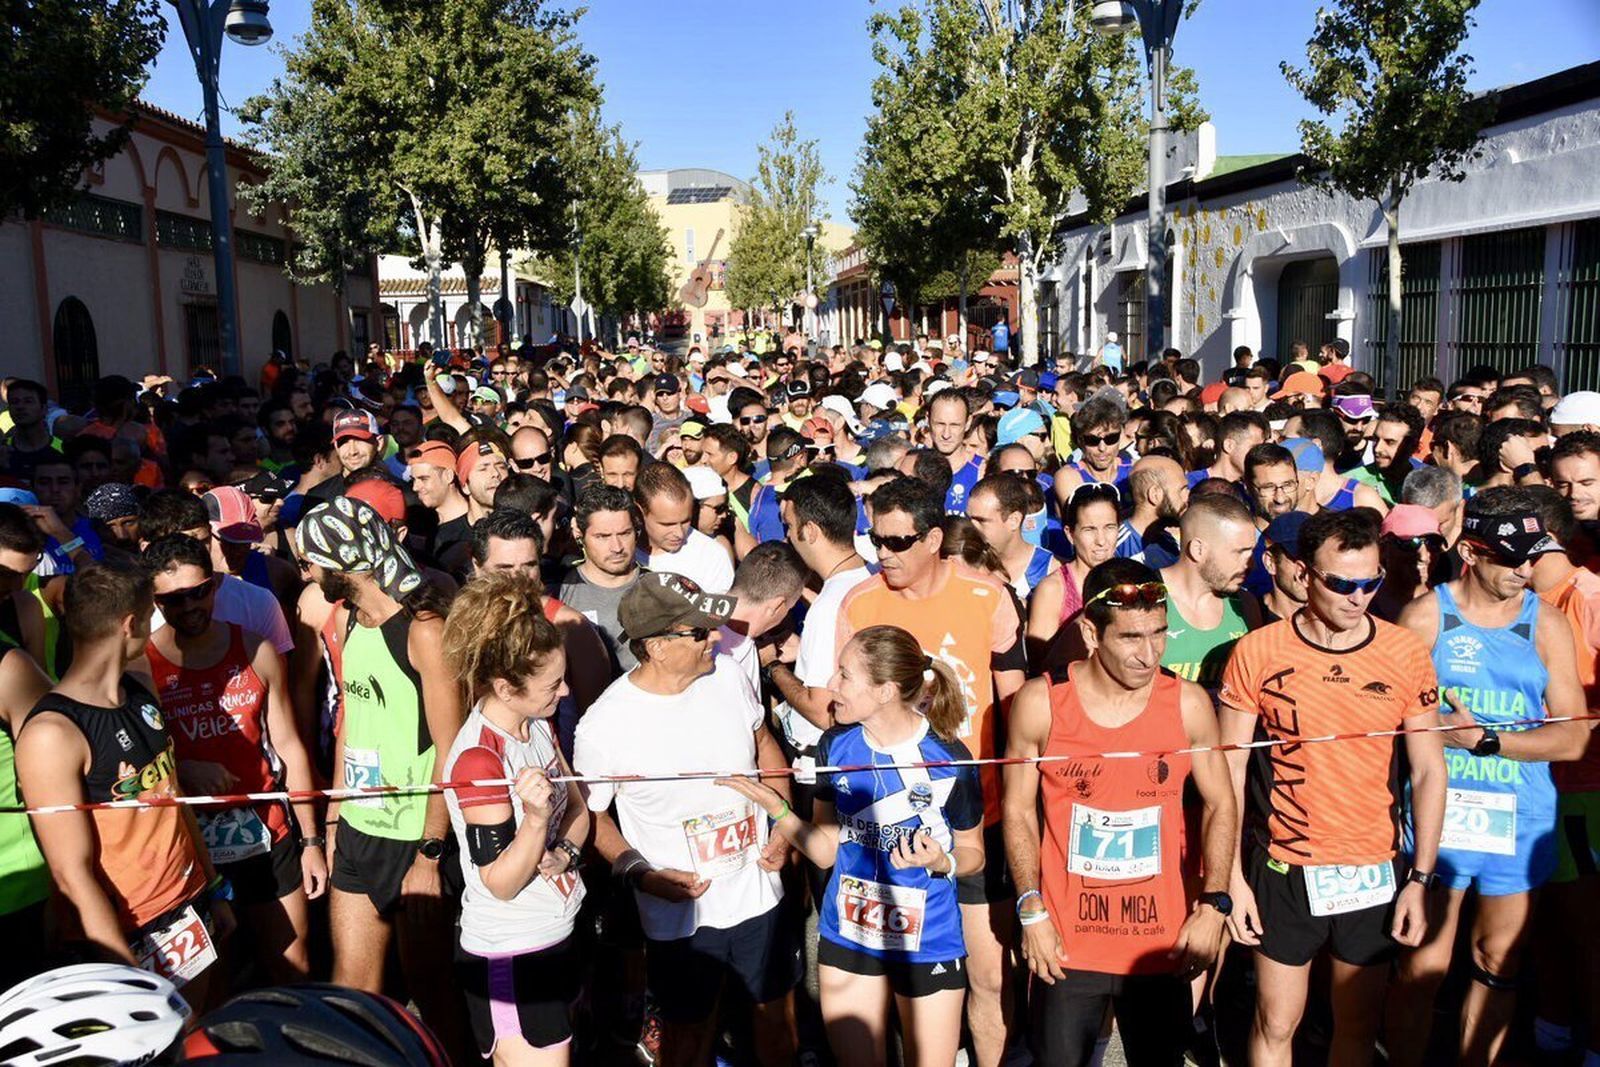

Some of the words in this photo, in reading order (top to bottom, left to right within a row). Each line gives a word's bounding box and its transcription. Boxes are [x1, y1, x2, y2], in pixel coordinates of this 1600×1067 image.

[695, 820, 753, 863] 742
[1091, 829, 1135, 861] 71
[847, 898, 910, 933] 746
[1079, 892, 1109, 922] CON
[1120, 894, 1158, 923] MIGA
[1131, 926, 1140, 936] &
[140, 930, 202, 974] 752
